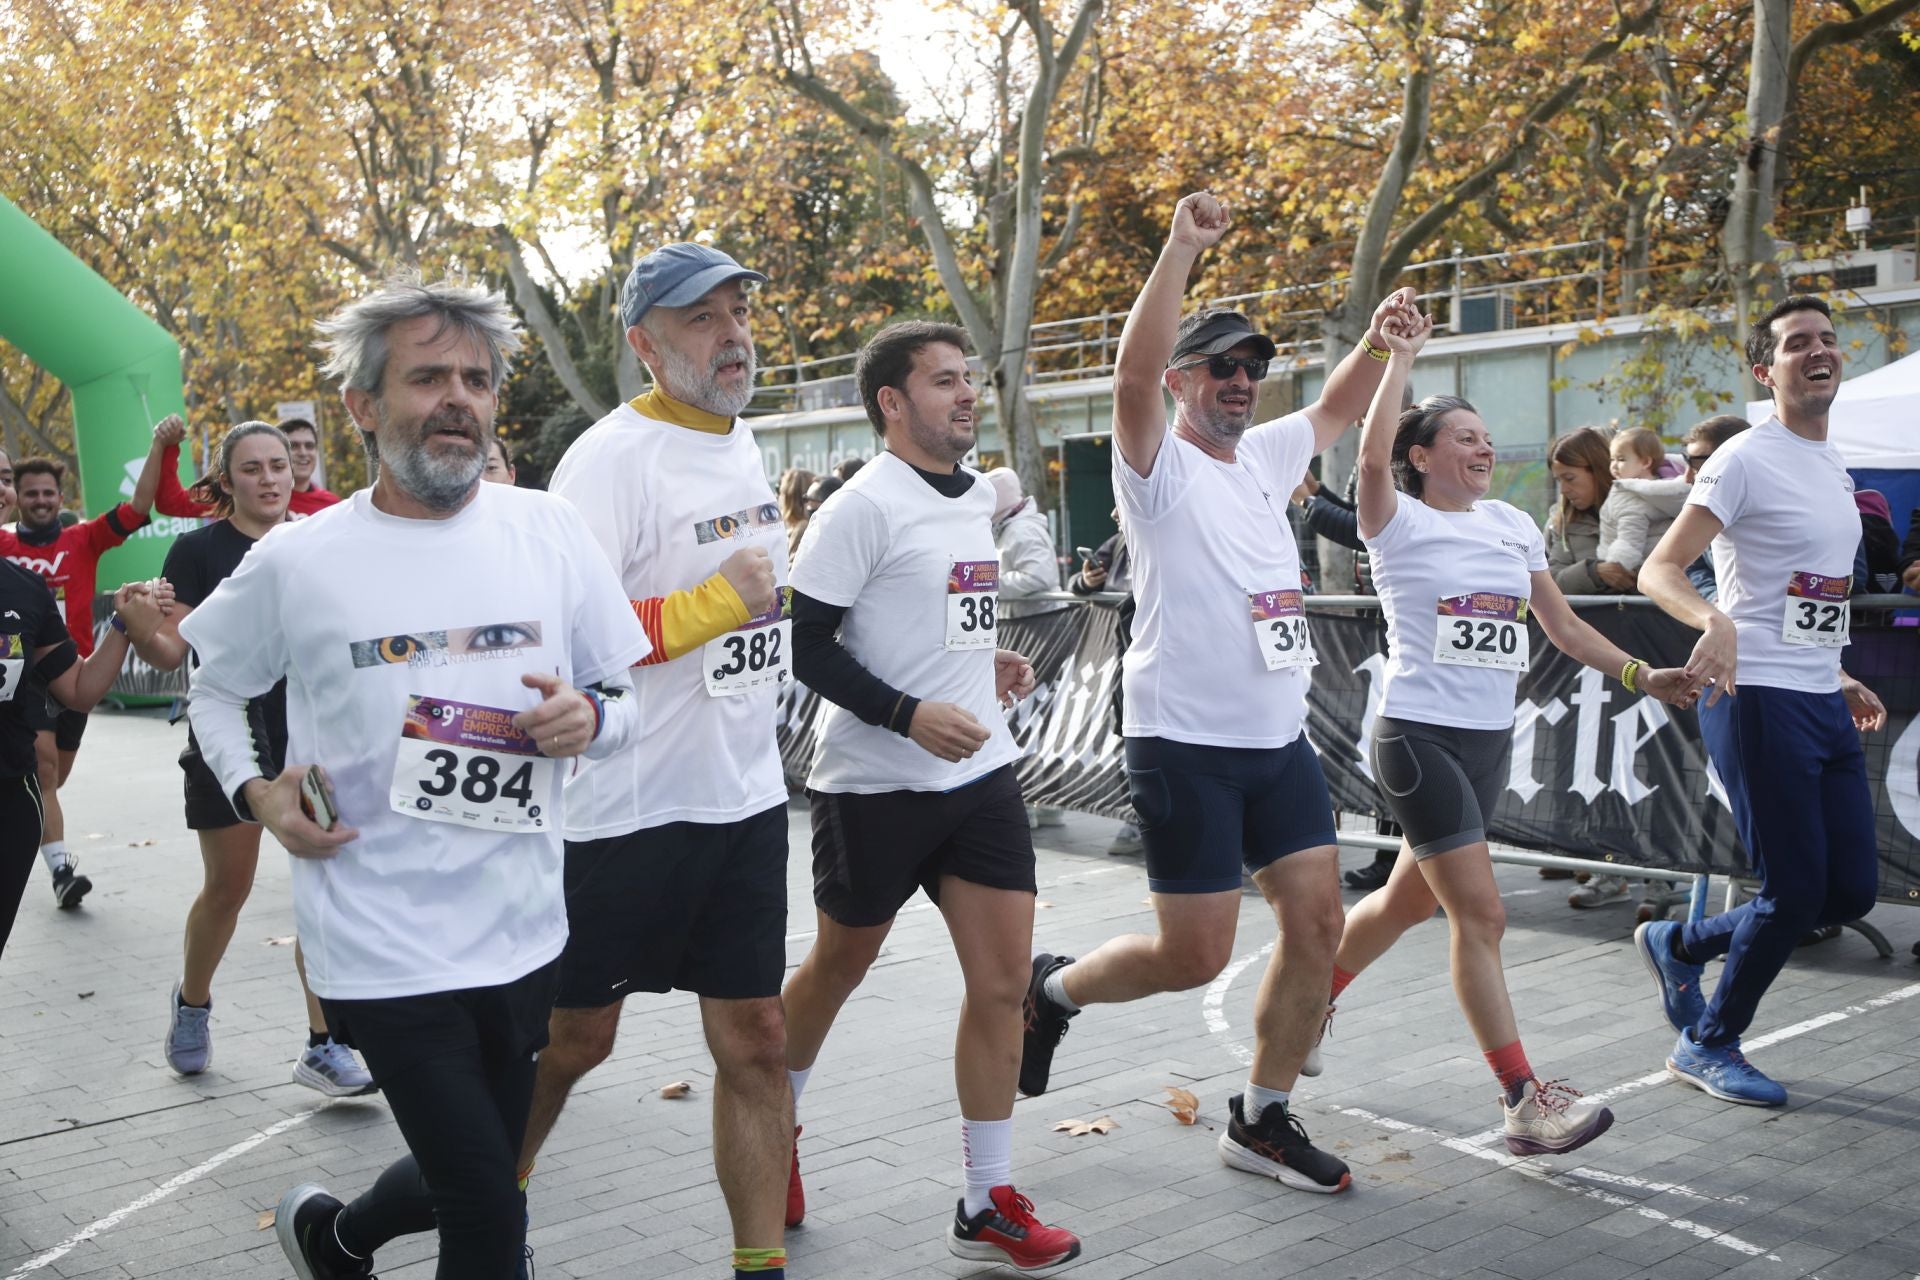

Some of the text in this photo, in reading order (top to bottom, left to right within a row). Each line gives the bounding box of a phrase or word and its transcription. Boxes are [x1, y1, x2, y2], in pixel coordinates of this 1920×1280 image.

[963, 565, 974, 581] 9ª
[1809, 576, 1823, 589] 9ª
[1265, 594, 1277, 609] 9ª
[1471, 600, 1506, 612] EMPRESAS
[1795, 602, 1847, 632] 321
[1270, 619, 1307, 652] 319
[1451, 620, 1517, 654] 320
[408, 649, 524, 669] POR LA NATURALEZA
[721, 627, 782, 675] 382
[441, 704, 464, 727] 9ª
[462, 719, 524, 740] EMPRESAS
[419, 748, 534, 808] 384
